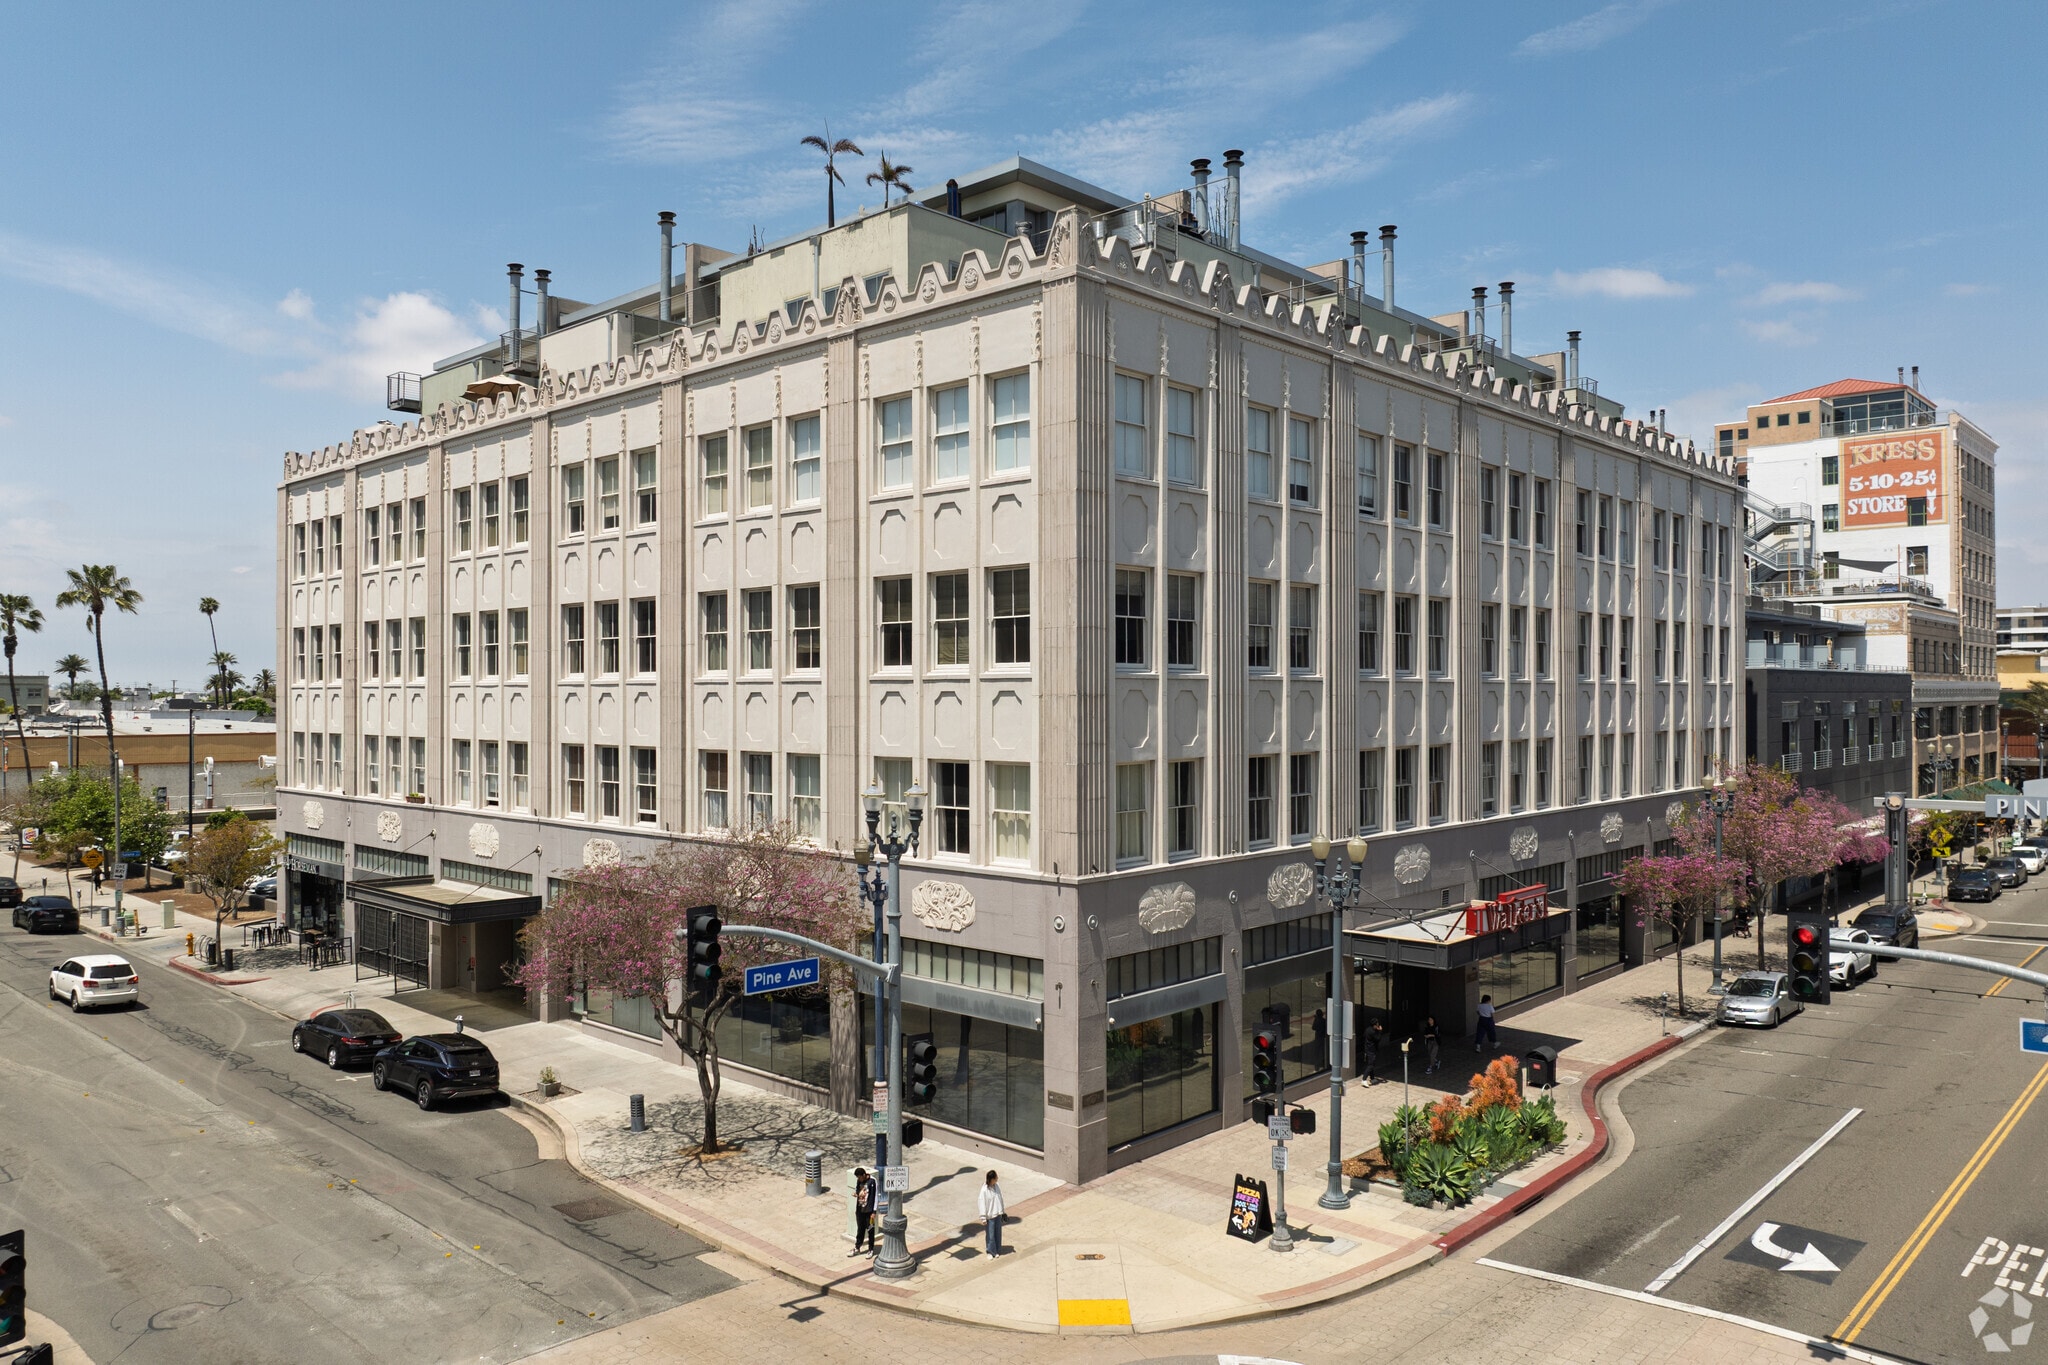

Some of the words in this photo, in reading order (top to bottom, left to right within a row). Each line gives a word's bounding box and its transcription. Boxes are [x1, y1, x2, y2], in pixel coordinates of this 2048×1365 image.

[1849, 439, 1936, 468] KRESS
[1847, 495, 1907, 515] STORE
[1996, 799, 2048, 817] PIN
[753, 972, 782, 987] Pine
[787, 967, 812, 982] Ave
[1270, 1128, 1280, 1137] OK
[886, 1179, 895, 1188] OK
[1235, 1192, 1260, 1206] BEER
[1236, 1185, 1260, 1199] PIZZA
